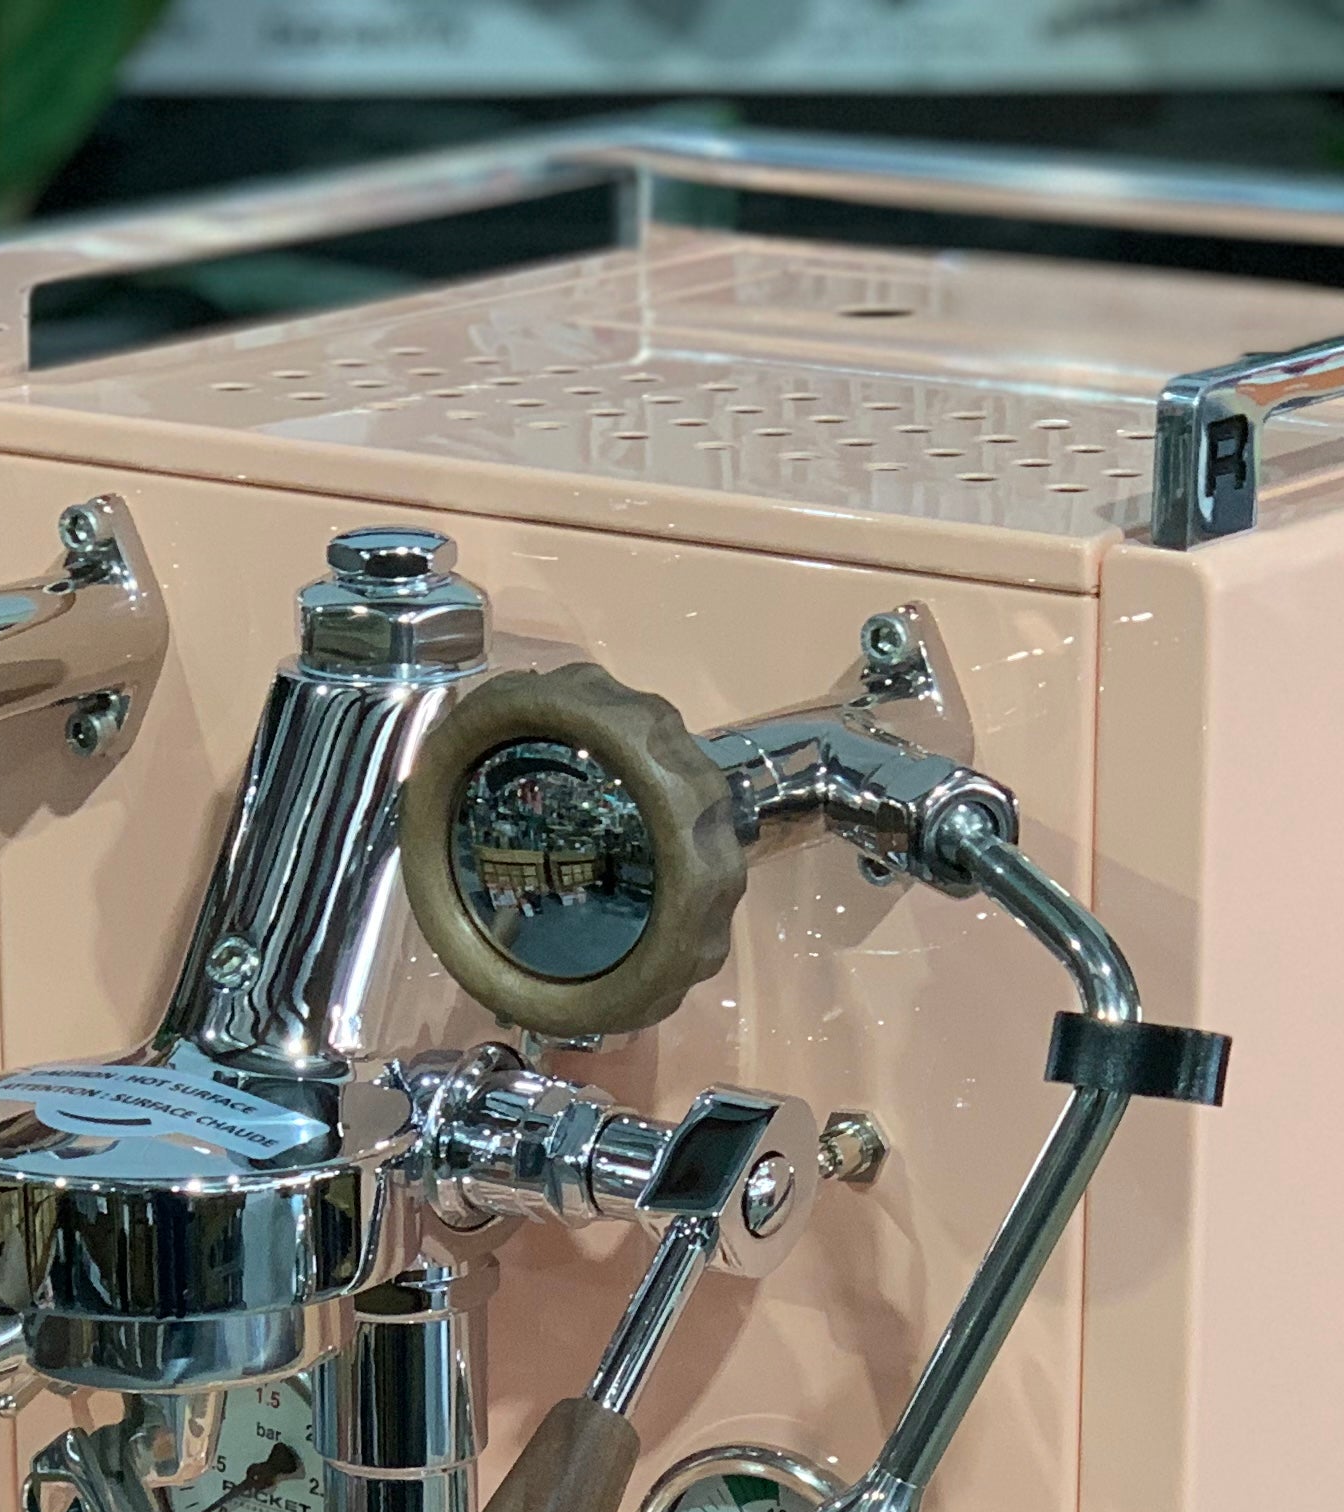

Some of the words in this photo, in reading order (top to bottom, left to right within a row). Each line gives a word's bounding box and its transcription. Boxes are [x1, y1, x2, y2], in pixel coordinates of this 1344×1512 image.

[1205, 413, 1249, 498] R
[125, 1074, 170, 1088] HOT
[169, 1083, 258, 1114] SURFACE
[110, 1093, 197, 1120] SURFACE
[196, 1115, 279, 1148] CHAUDE
[256, 1387, 281, 1409] 1.5
[256, 1421, 282, 1441] bar
